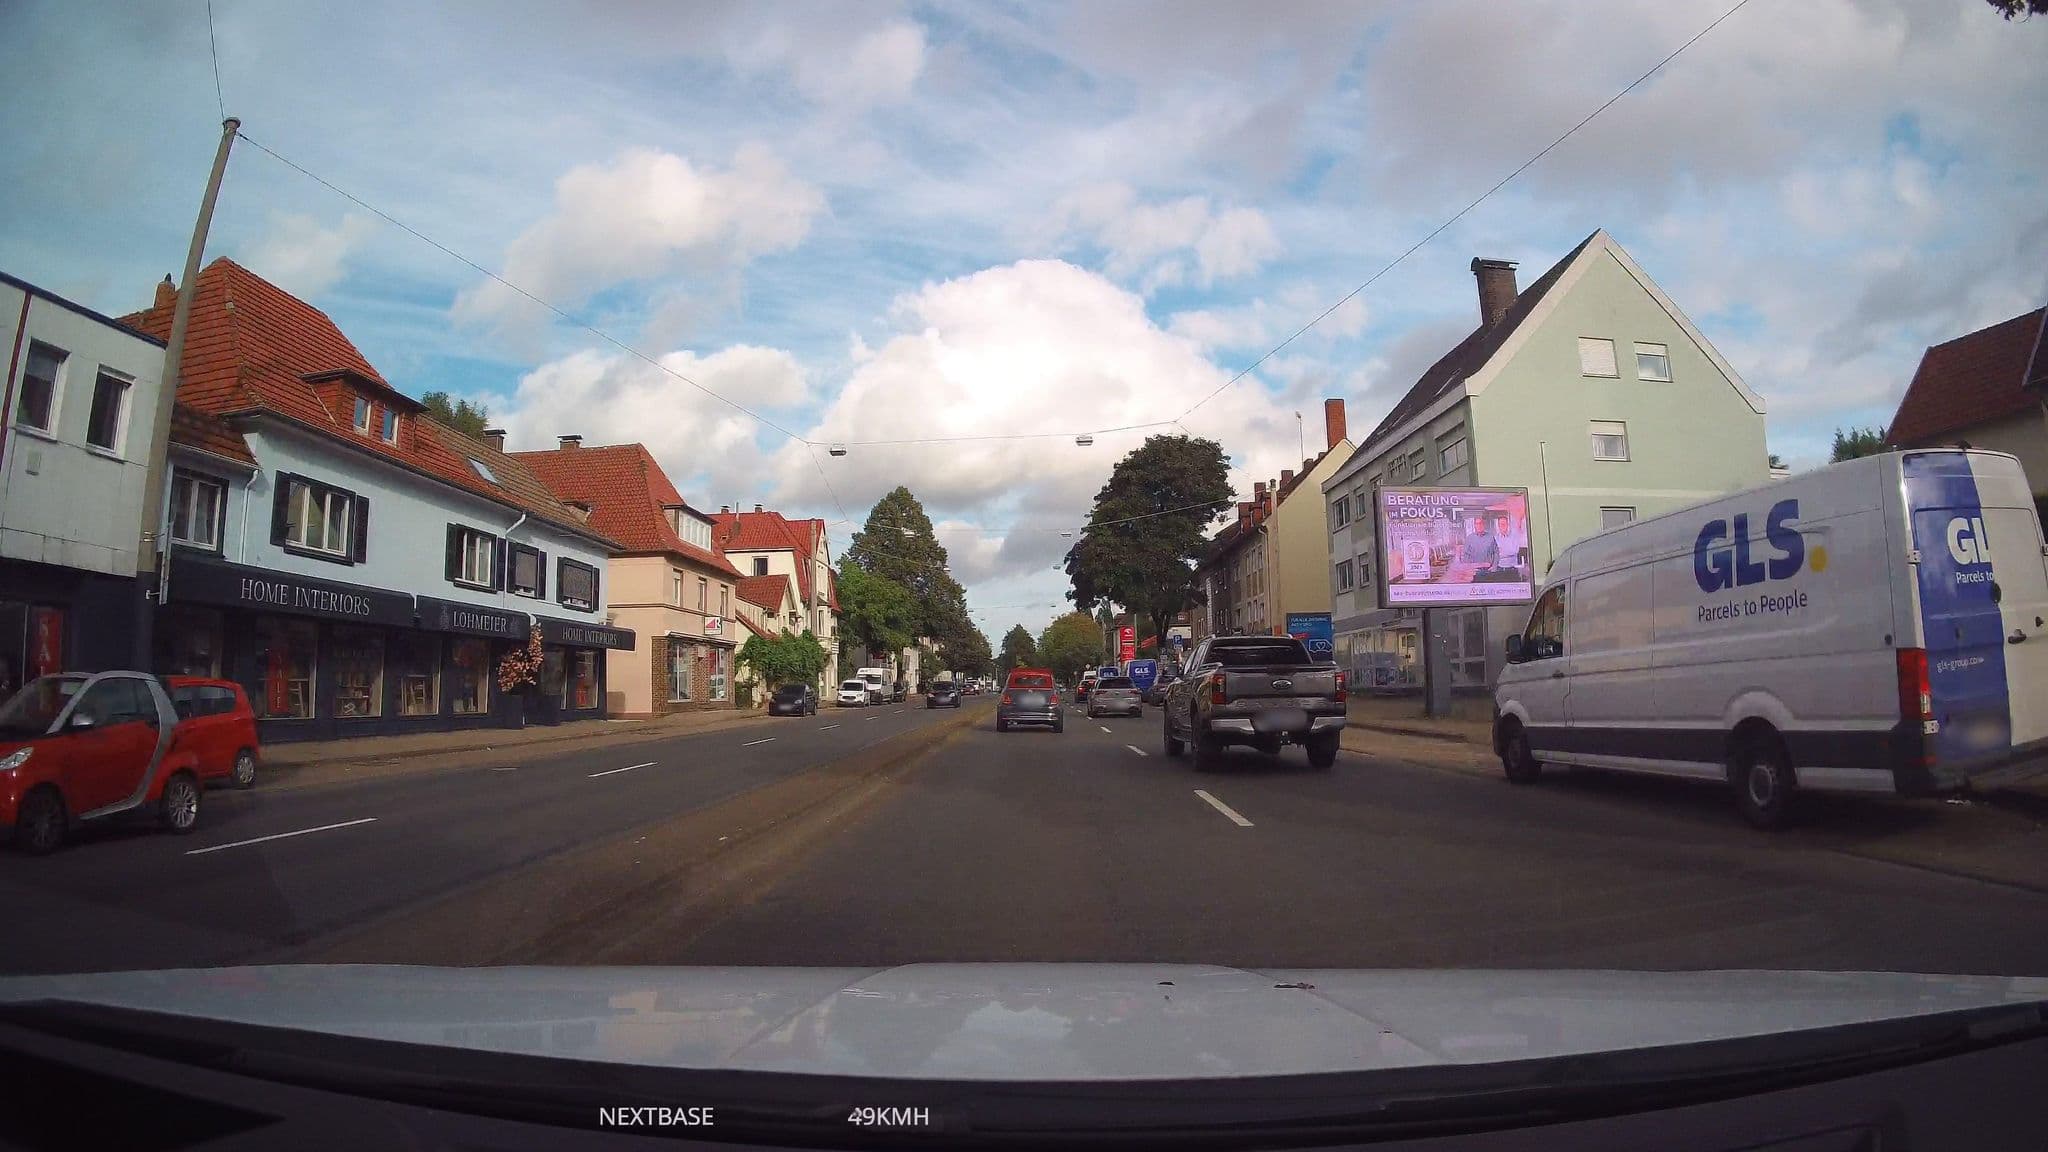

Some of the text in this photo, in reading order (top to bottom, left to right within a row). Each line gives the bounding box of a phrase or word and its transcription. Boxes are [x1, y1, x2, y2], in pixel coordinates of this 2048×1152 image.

[1387, 495, 1459, 506] BERATUNG
[1400, 507, 1447, 518] FOKUS.
[1956, 571, 1985, 584] Parcels
[240, 578, 370, 616] HOME INTERIORS
[1698, 590, 1808, 622] Parcels to People
[453, 611, 508, 633] LOHMEIER
[561, 625, 618, 646] HOME INTERIORS
[1937, 656, 1985, 673] gls-group.co
